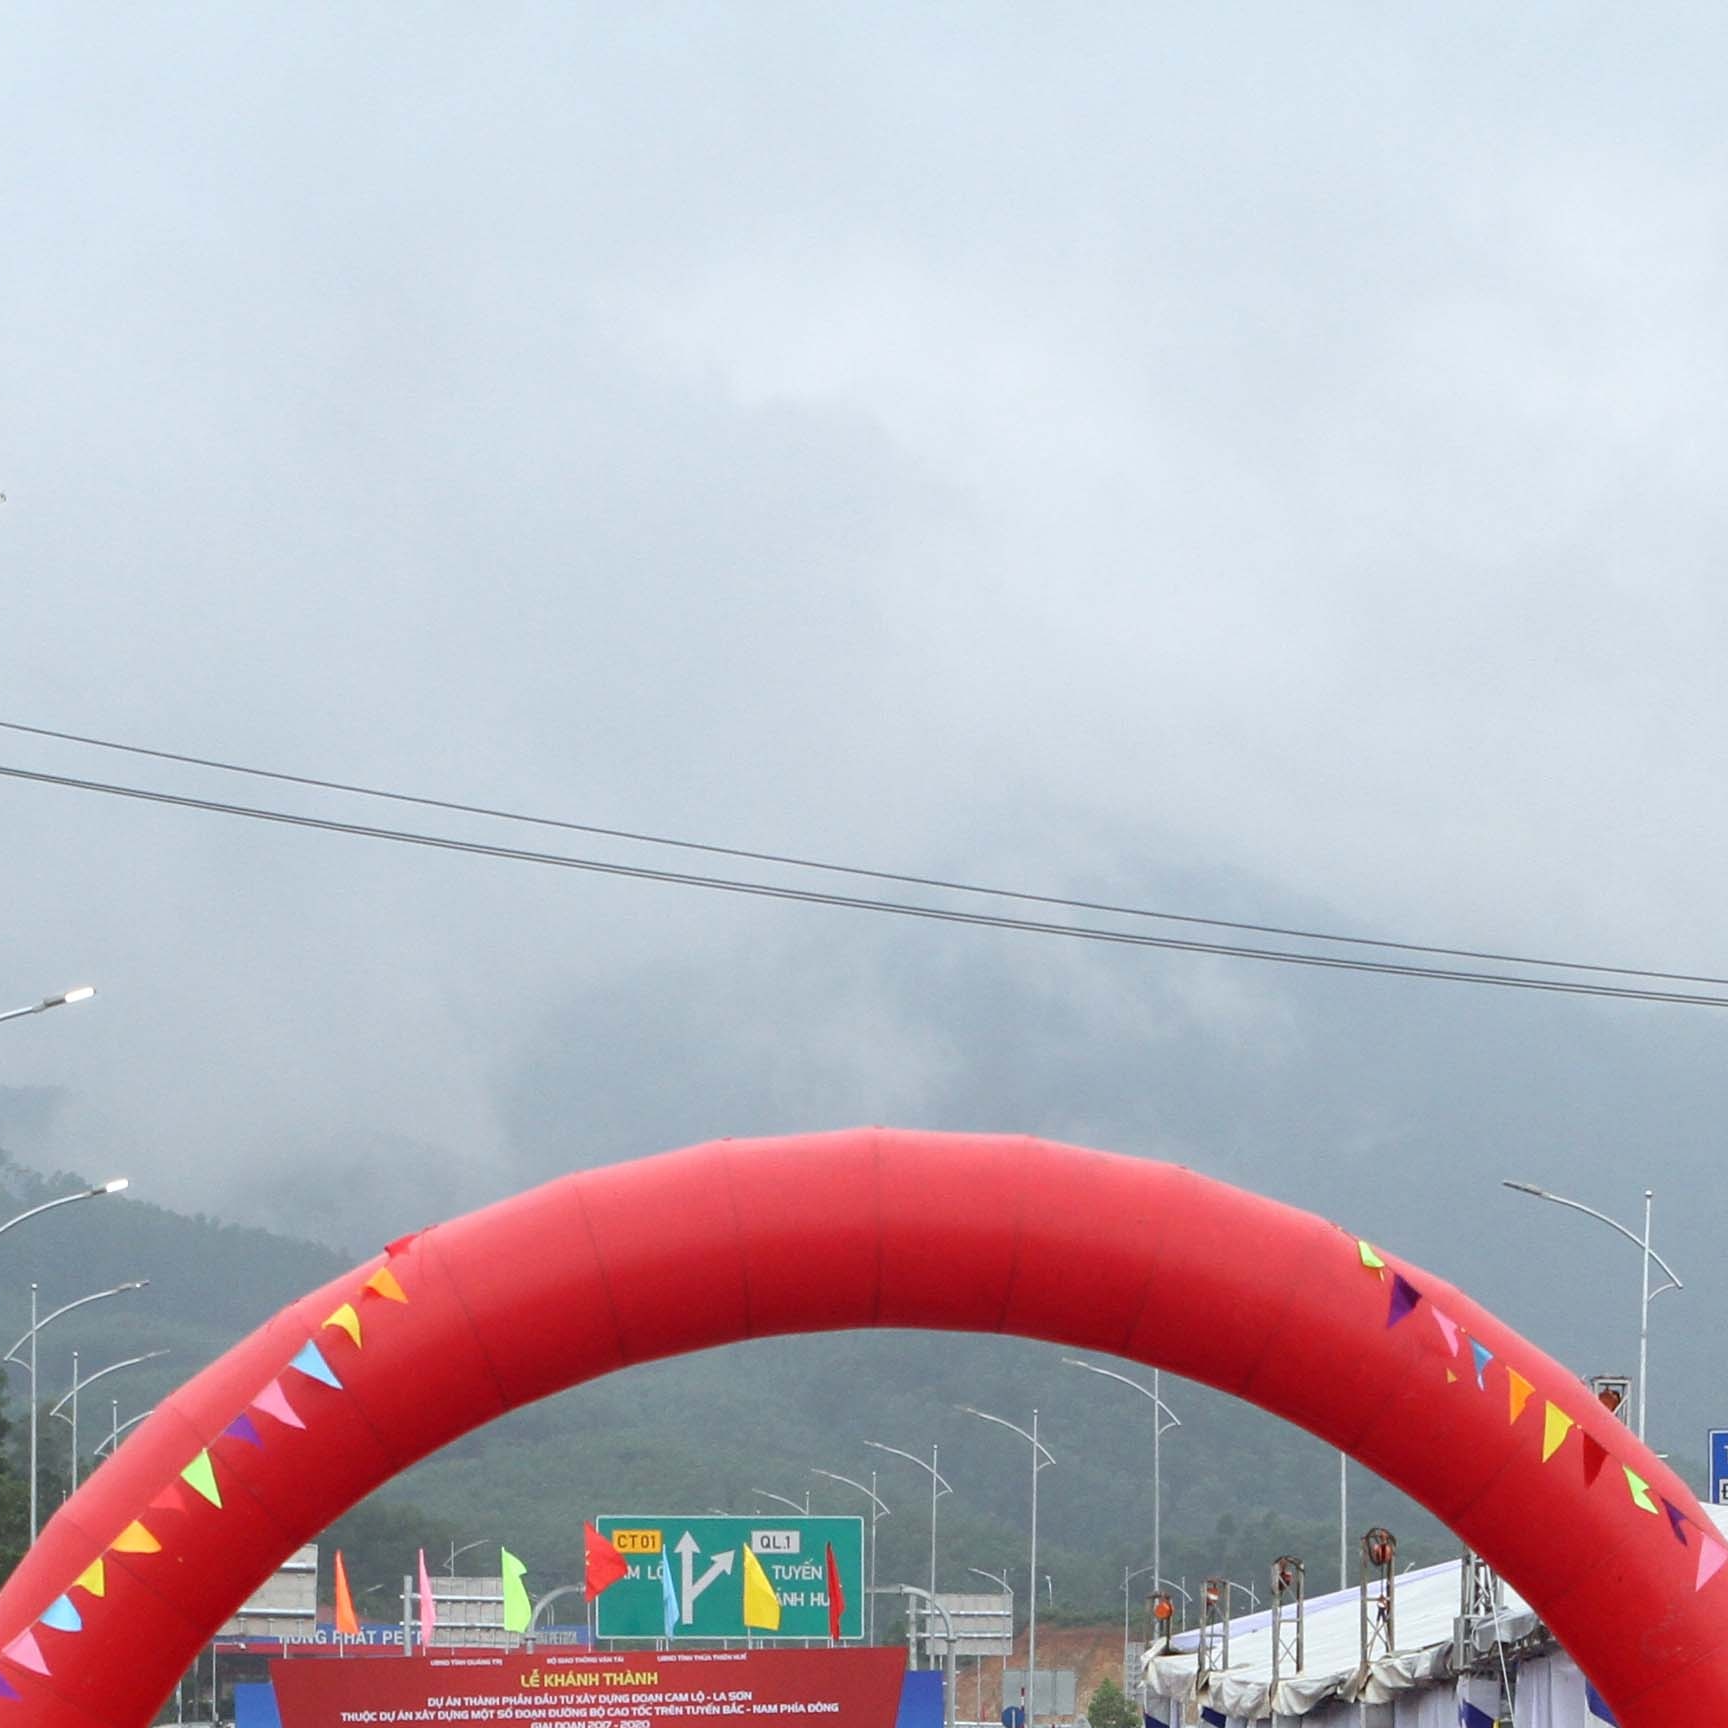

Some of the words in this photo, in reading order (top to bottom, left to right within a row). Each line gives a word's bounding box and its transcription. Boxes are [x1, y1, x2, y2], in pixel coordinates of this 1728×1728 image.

[760, 1535, 790, 1549] QL.1
[772, 1558, 823, 1580] TUYẾN
[776, 1587, 805, 1607] ÁNH
[810, 1591, 831, 1607] HU
[520, 1669, 540, 1688] LỄ
[543, 1669, 600, 1688] KHÁNH
[603, 1670, 659, 1687] THÀNH
[427, 1697, 444, 1709] DỰ
[445, 1695, 461, 1707] ÁN
[463, 1695, 500, 1707] THÀNH
[502, 1693, 533, 1707] PHẦN
[534, 1692, 558, 1705] ĐẦU
[559, 1694, 574, 1704] TƯ
[575, 1692, 598, 1704] XÂY
[599, 1694, 630, 1706] DỰNG
[632, 1692, 663, 1706] ĐOẠN
[665, 1692, 689, 1703] CAM
[691, 1690, 705, 1704] LỘ
[713, 1692, 728, 1702] LA
[728, 1690, 753, 1701] SƠN
[341, 1710, 377, 1724] THUỘC
[379, 1711, 395, 1723] DỰ
[397, 1710, 413, 1721] ÁN
[415, 1709, 436, 1721] XÂY
[437, 1711, 470, 1722] DỰNG
[471, 1708, 494, 1721] MỘT
[497, 1706, 513, 1719] SỐ
[515, 1708, 546, 1721] ĐOẠN
[589, 1706, 605, 1719] BỘ
[607, 1707, 630, 1717] CAO
[632, 1703, 653, 1717] TỐC
[655, 1703, 684, 1715] TRÊN
[685, 1702, 721, 1715] TUYẾN
[722, 1702, 745, 1714] BẮC
[752, 1704, 778, 1714] NAM
[780, 1701, 806, 1713] PHÍA
[807, 1701, 839, 1713] ĐÔNG
